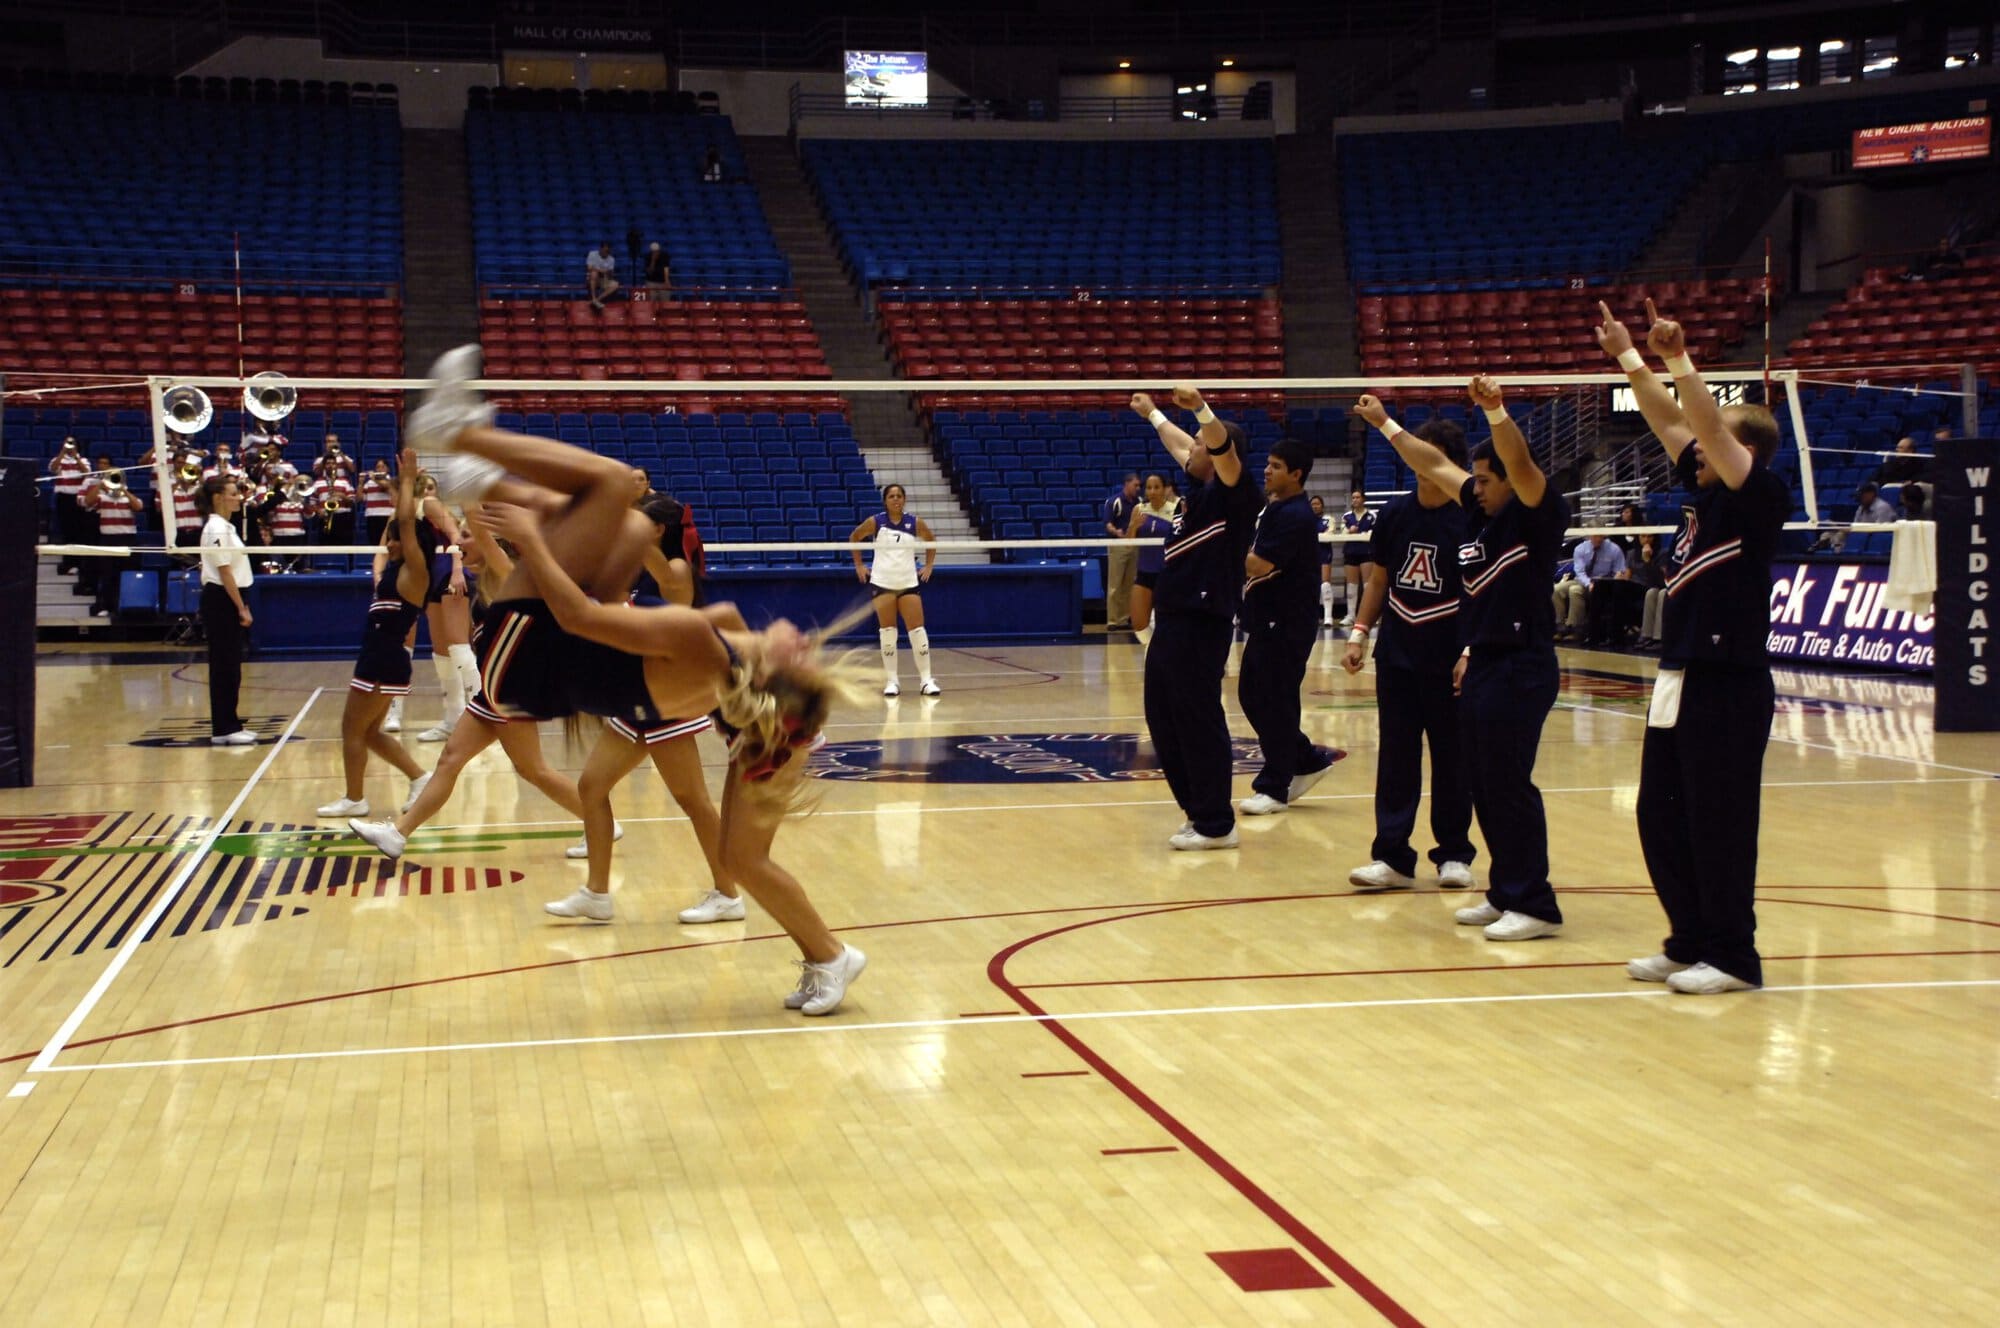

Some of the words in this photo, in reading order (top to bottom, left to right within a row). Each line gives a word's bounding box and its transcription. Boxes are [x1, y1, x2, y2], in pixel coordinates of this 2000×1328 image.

[513, 24, 548, 40] HALL
[572, 27, 653, 42] CHAMPIONS
[863, 53, 879, 64] The
[1859, 128, 1885, 138] NEW
[1888, 123, 1927, 135] ONLINE
[1931, 119, 1985, 131] AUCTIONS
[180, 284, 195, 295] 20
[634, 291, 646, 301] 21
[1077, 291, 1090, 301] 22
[664, 405, 676, 415] 21
[893, 534, 901, 543] 7
[1396, 541, 1443, 594] A
[1965, 467, 1991, 686] WILDCATS
[1800, 631, 1831, 657] Tire
[1833, 633, 1849, 659] &
[1848, 634, 1893, 662] Auto
[1895, 637, 1936, 666] Care
